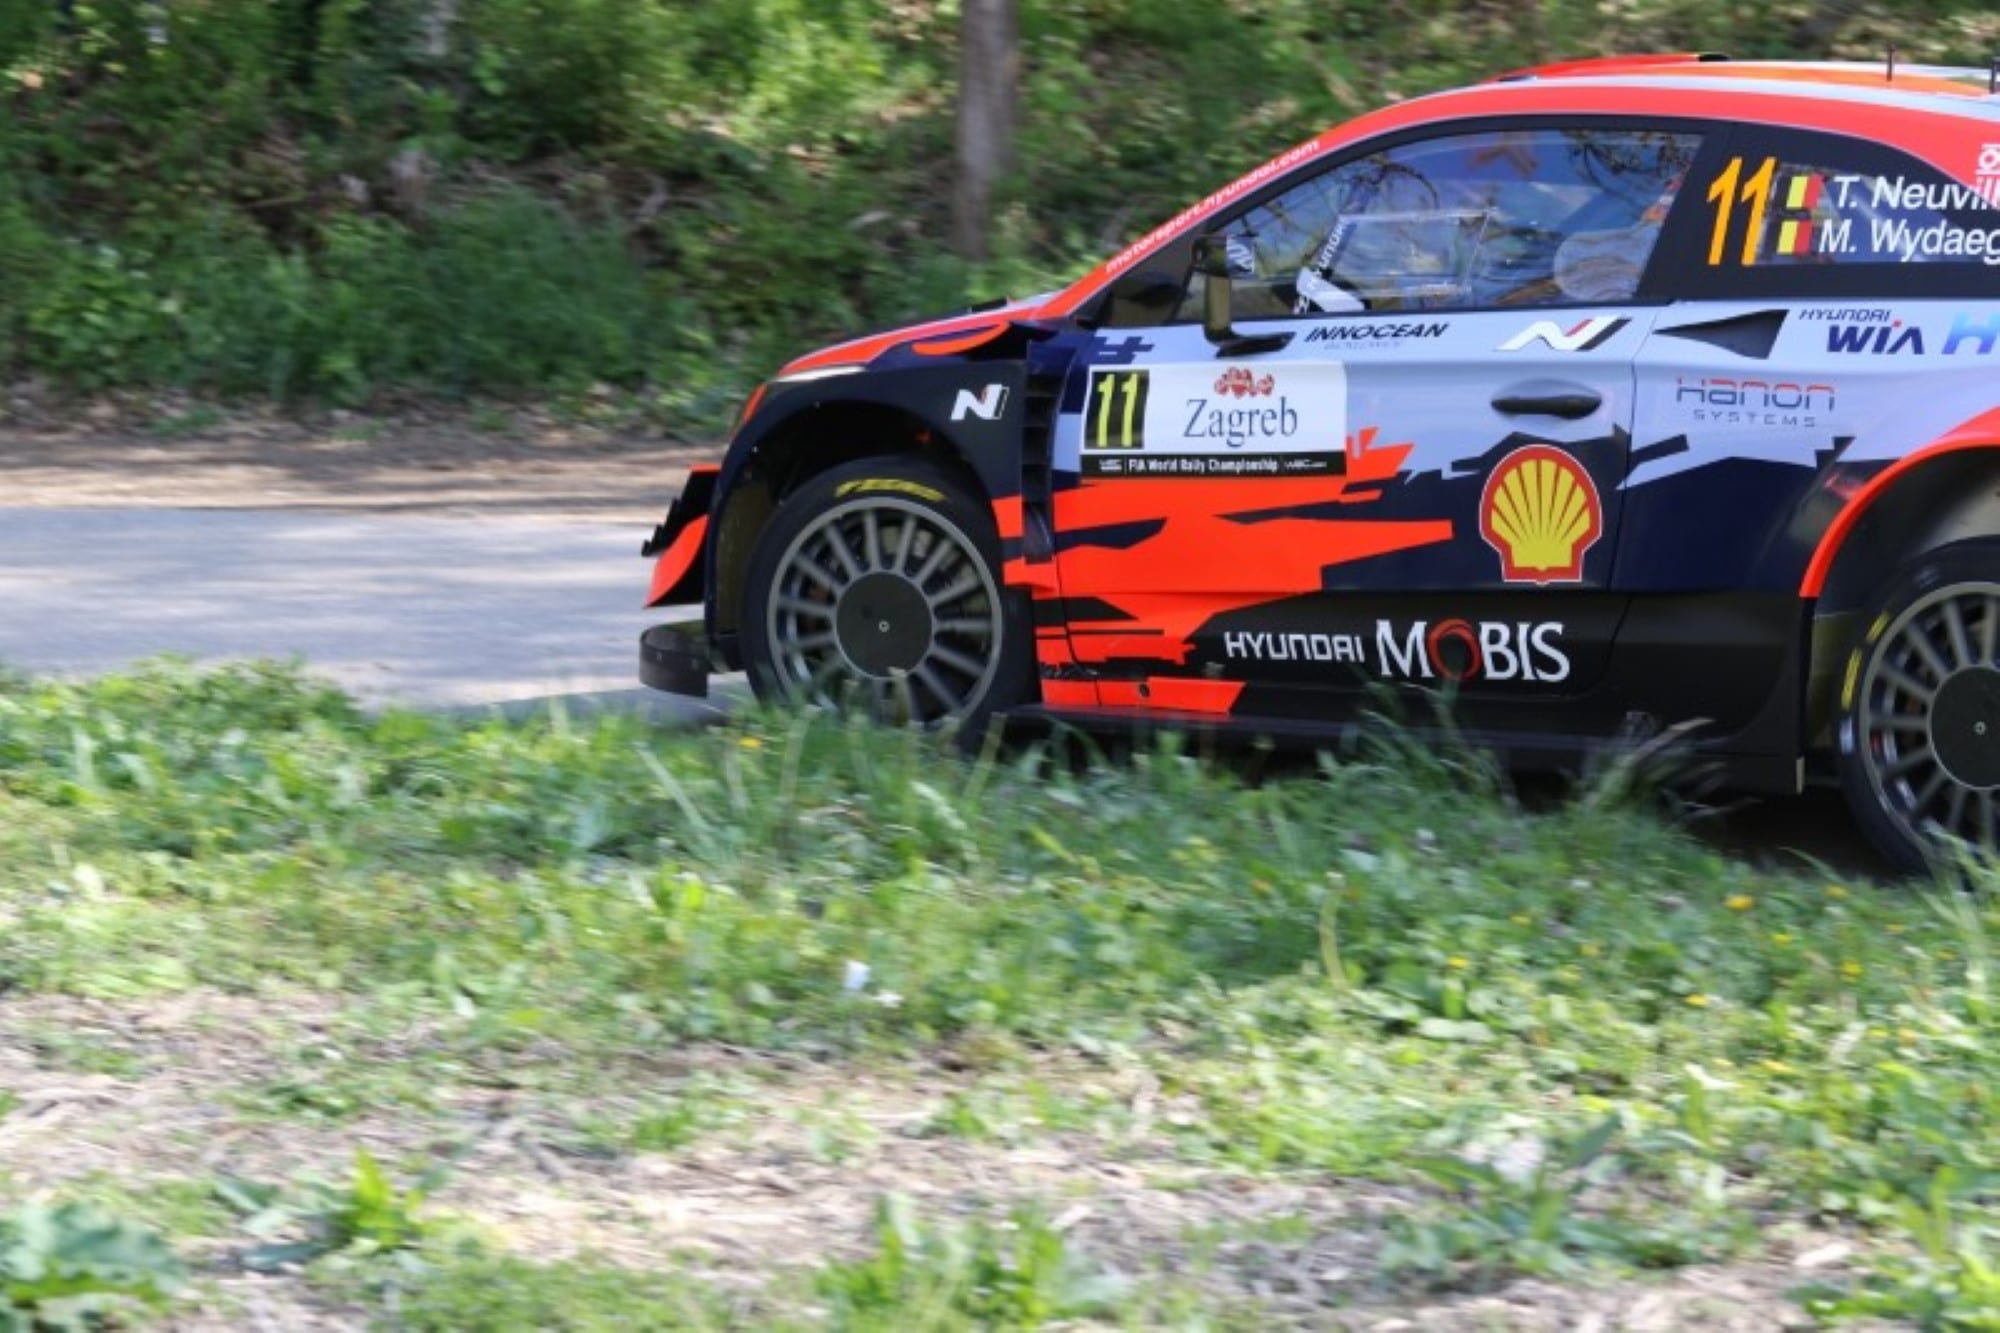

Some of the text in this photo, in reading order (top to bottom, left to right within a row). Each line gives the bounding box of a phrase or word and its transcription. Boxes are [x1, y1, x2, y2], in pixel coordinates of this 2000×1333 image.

[1833, 175, 2000, 210] T. Neuvill
[1706, 156, 1777, 265] 11
[1818, 219, 1856, 252] M.
[1304, 321, 1450, 342] INNOCEAN
[1799, 308, 1892, 322] HYUNDAI
[1097, 373, 1140, 447] 11
[1183, 396, 1298, 447] Zagreb
[1693, 409, 1816, 428] SYSTEMS
[1128, 458, 1146, 471] FIA
[1149, 458, 1177, 471] World
[1181, 458, 1206, 474] Rally
[1208, 457, 1278, 474] Championship
[1224, 618, 1571, 683] HYUNDAI MOBIS
